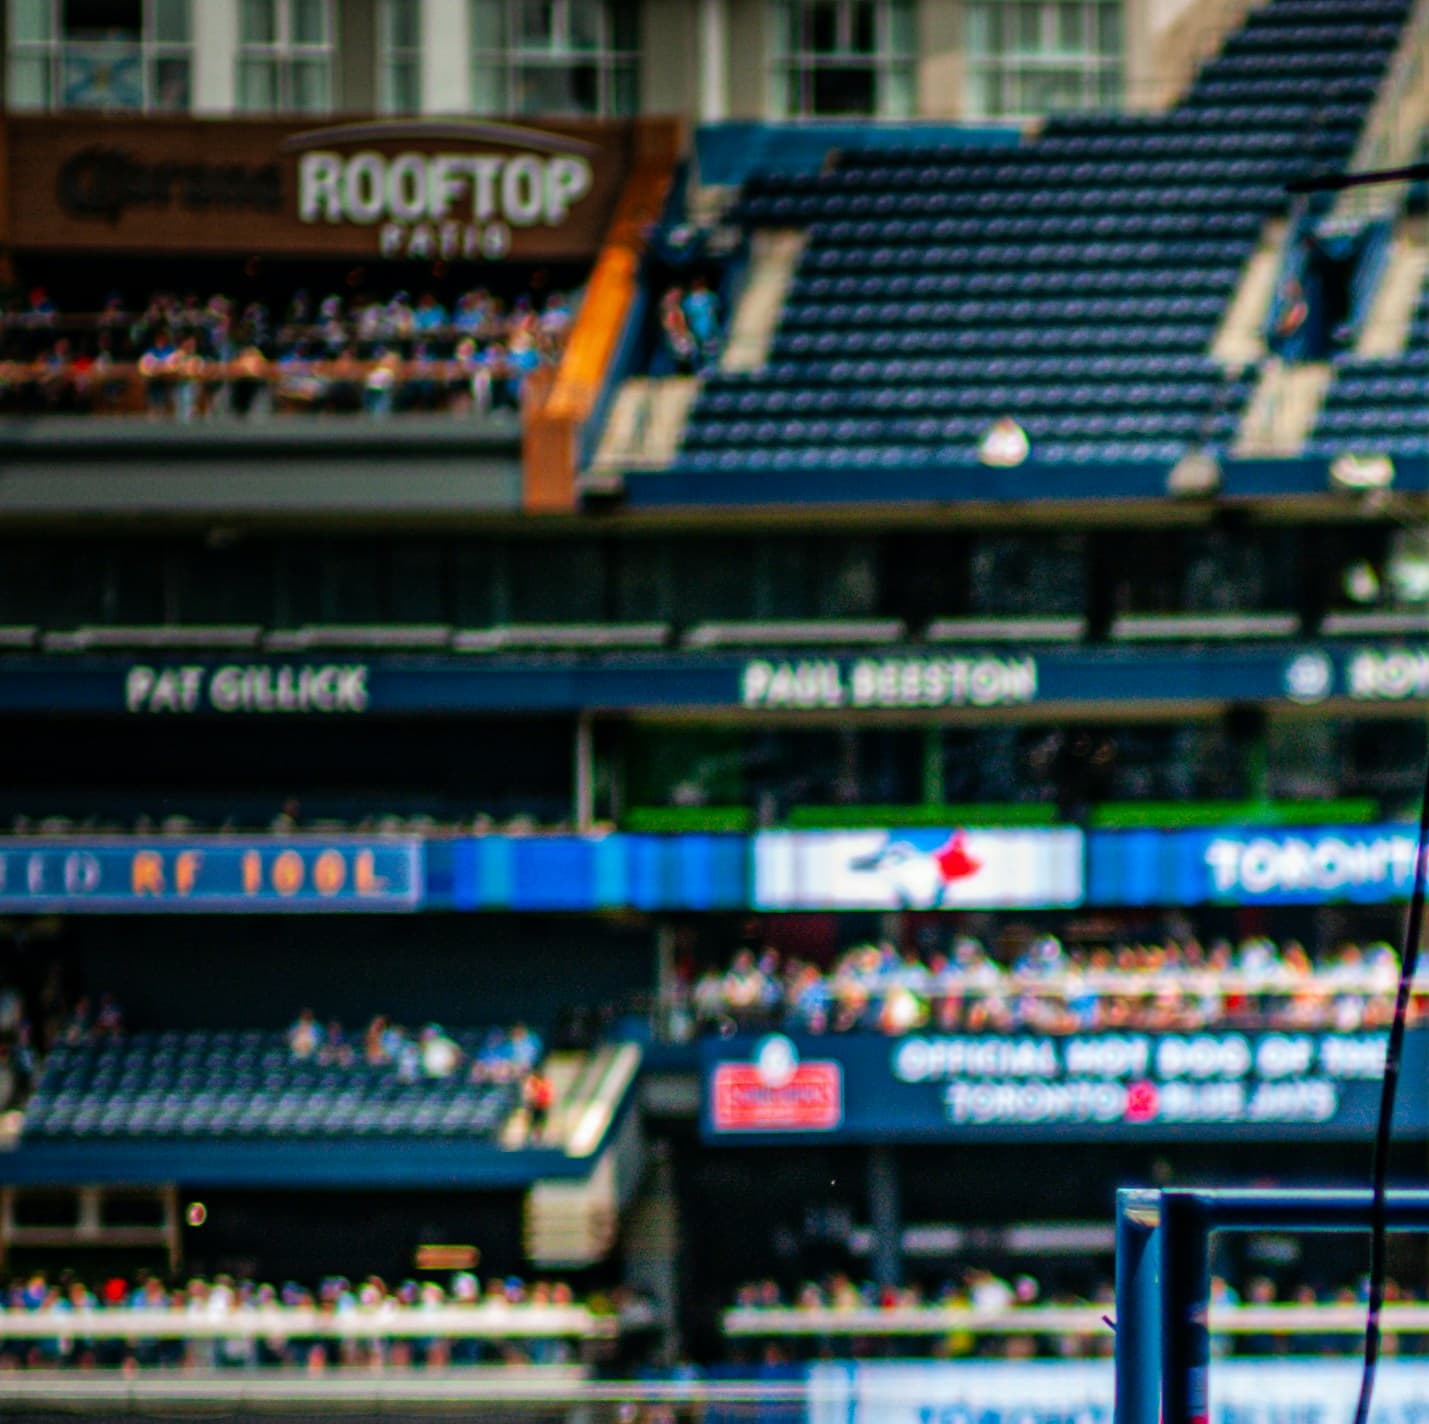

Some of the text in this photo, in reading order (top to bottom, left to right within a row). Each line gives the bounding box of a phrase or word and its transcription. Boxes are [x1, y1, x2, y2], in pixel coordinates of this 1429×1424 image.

[298, 152, 593, 225] ROOFTOP
[379, 222, 512, 260] PATIO
[126, 664, 369, 713] PAT GILLICK
[740, 655, 1037, 710] PAUL BEESTON
[896, 1036, 1057, 1081] OFFICIAL
[1157, 1032, 1251, 1077] DOG
[1256, 1032, 1314, 1077] OF
[947, 1079, 1127, 1123] TORONTO
